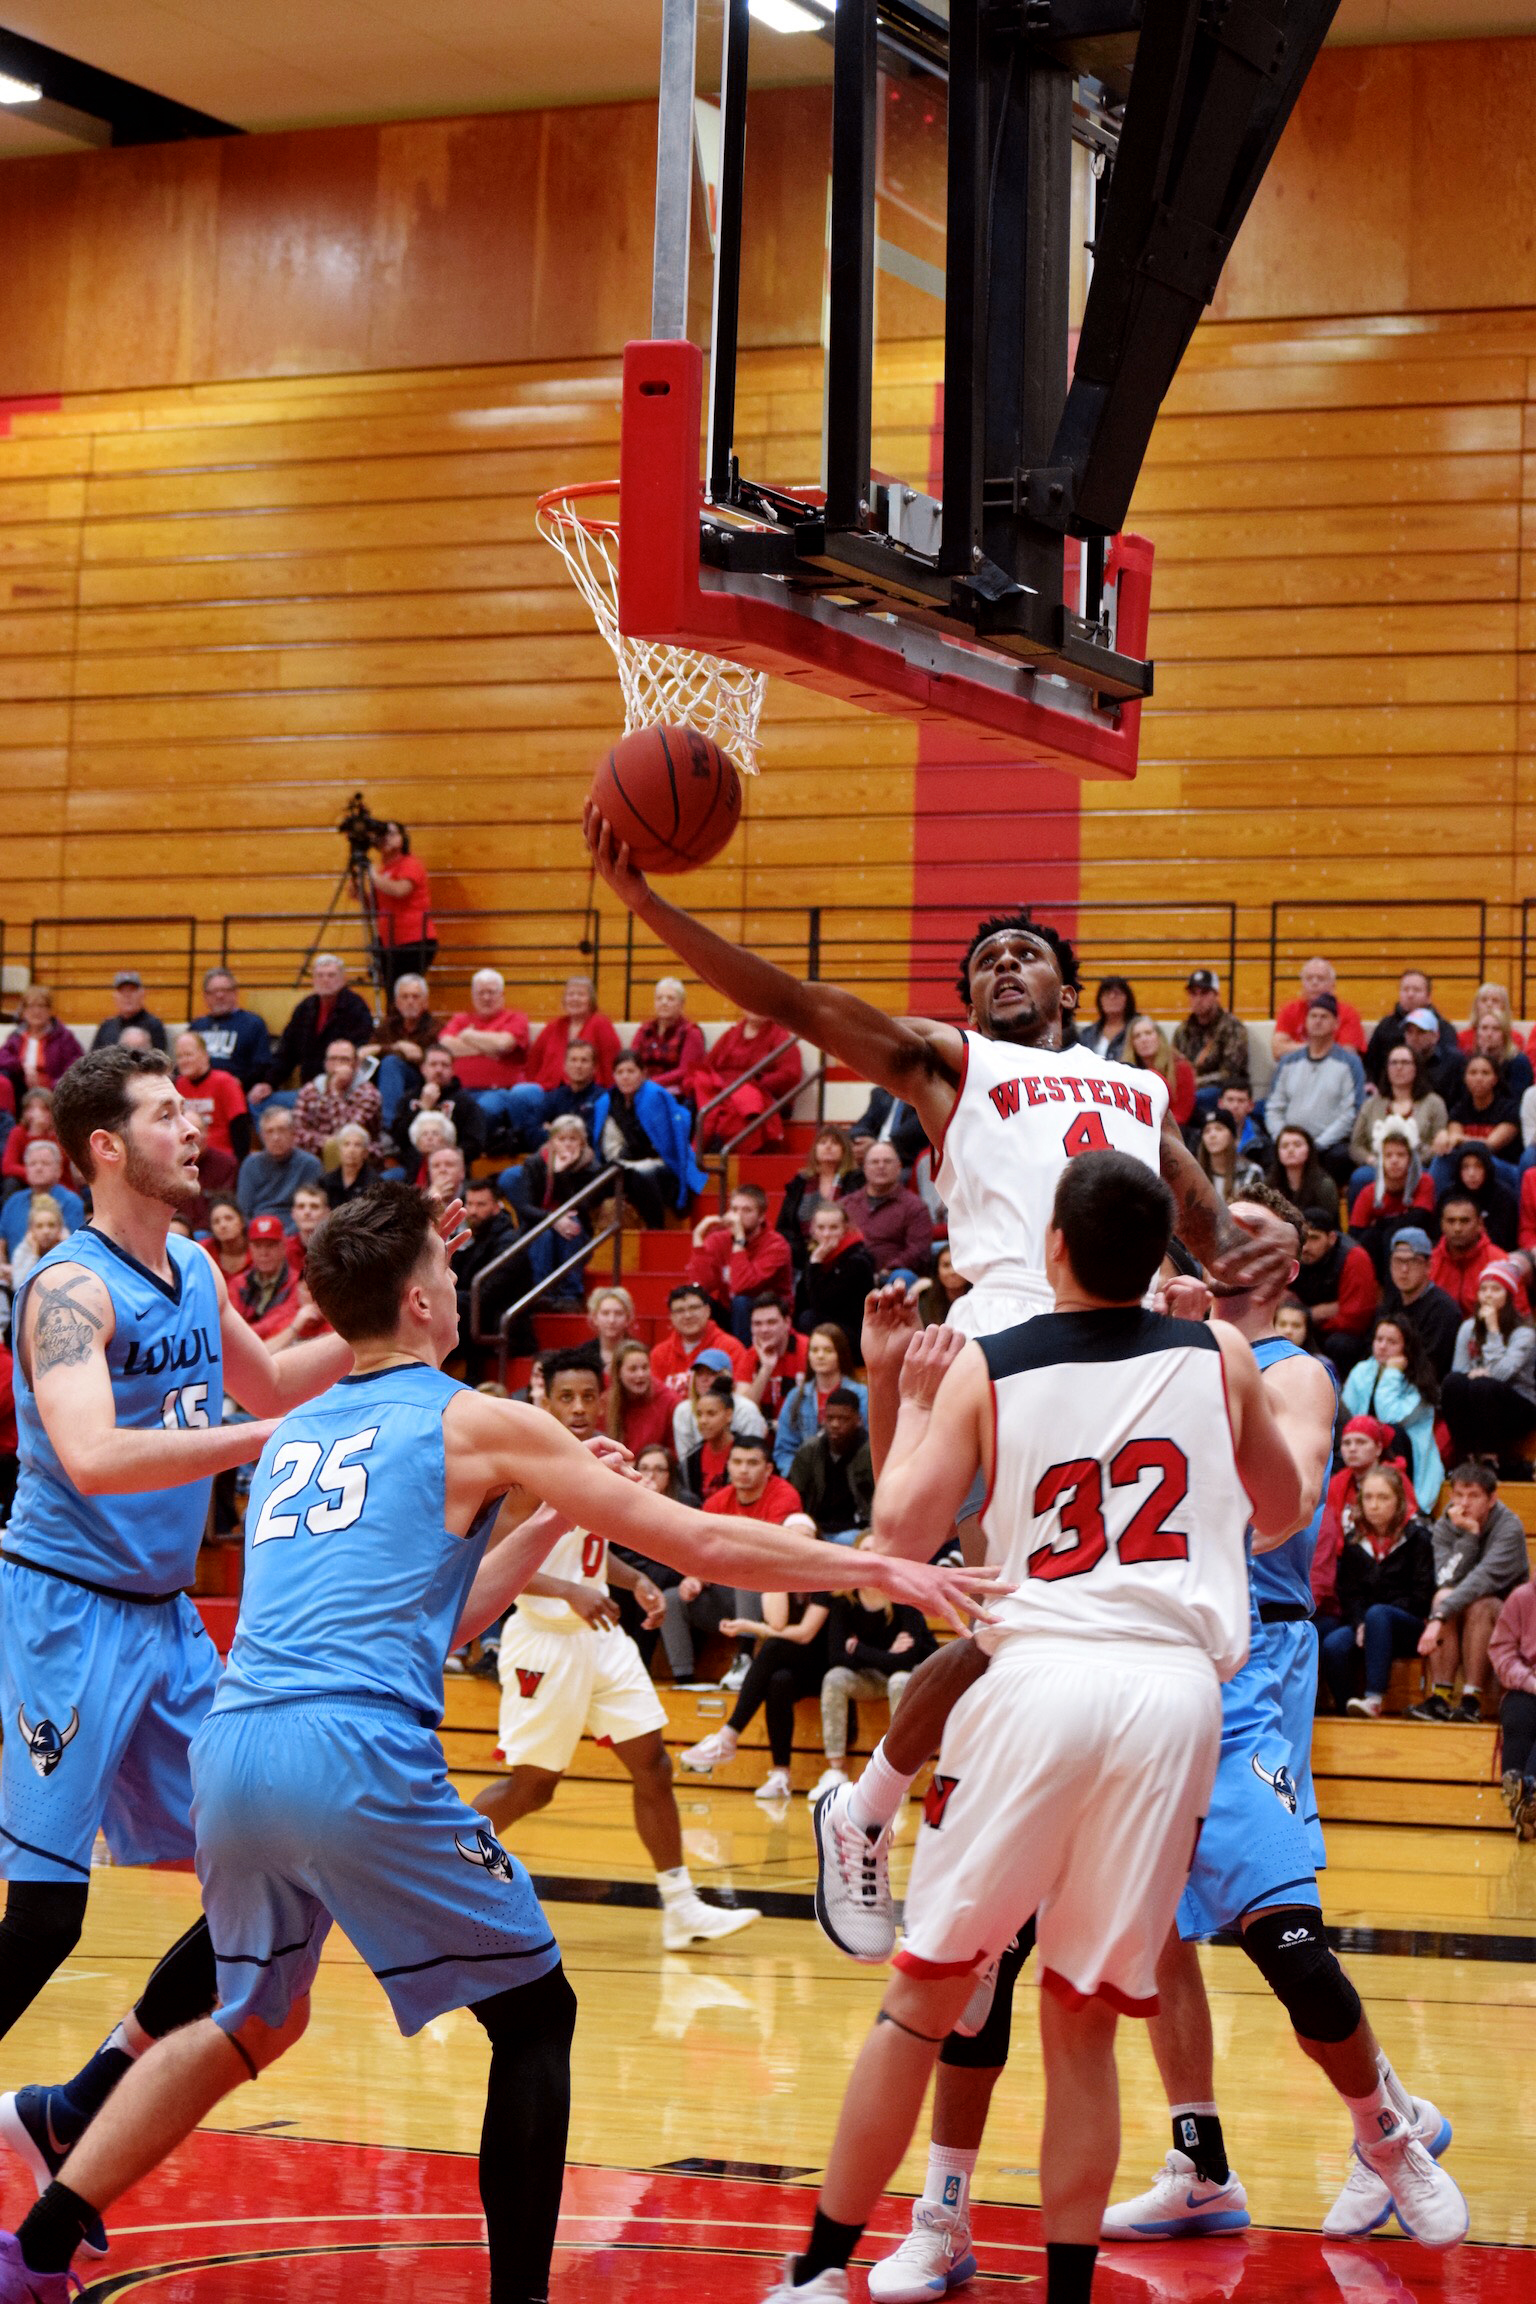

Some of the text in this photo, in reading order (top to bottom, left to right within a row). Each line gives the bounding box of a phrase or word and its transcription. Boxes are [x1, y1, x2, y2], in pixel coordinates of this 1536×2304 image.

[988, 1076, 1154, 1127] WESTERN
[1062, 1111, 1115, 1157] 4
[160, 1381, 210, 1430] 15
[252, 1425, 381, 1549] 25
[1027, 1438, 1190, 1582] 32
[582, 1533, 604, 1578] 0
[515, 1668, 545, 1699] W
